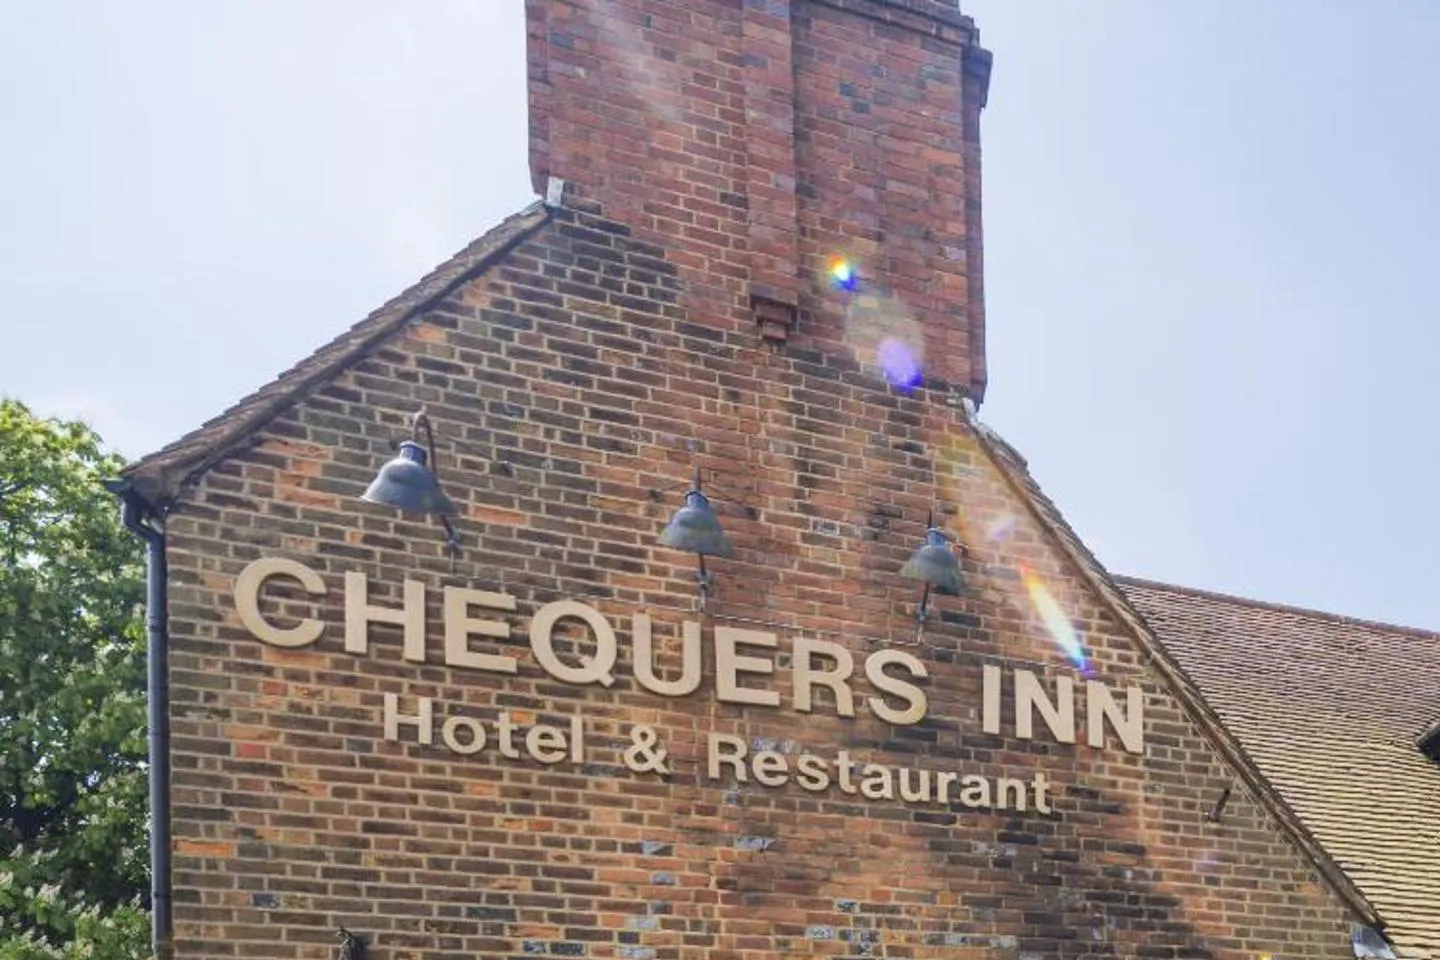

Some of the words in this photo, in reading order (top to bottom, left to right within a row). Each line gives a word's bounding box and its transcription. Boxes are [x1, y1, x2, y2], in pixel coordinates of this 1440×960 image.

[234, 557, 928, 725] CHEQUERS
[983, 665, 1145, 754] INN
[384, 692, 583, 764] Hotel
[623, 724, 671, 775] &
[708, 734, 1053, 815] Restaurant
